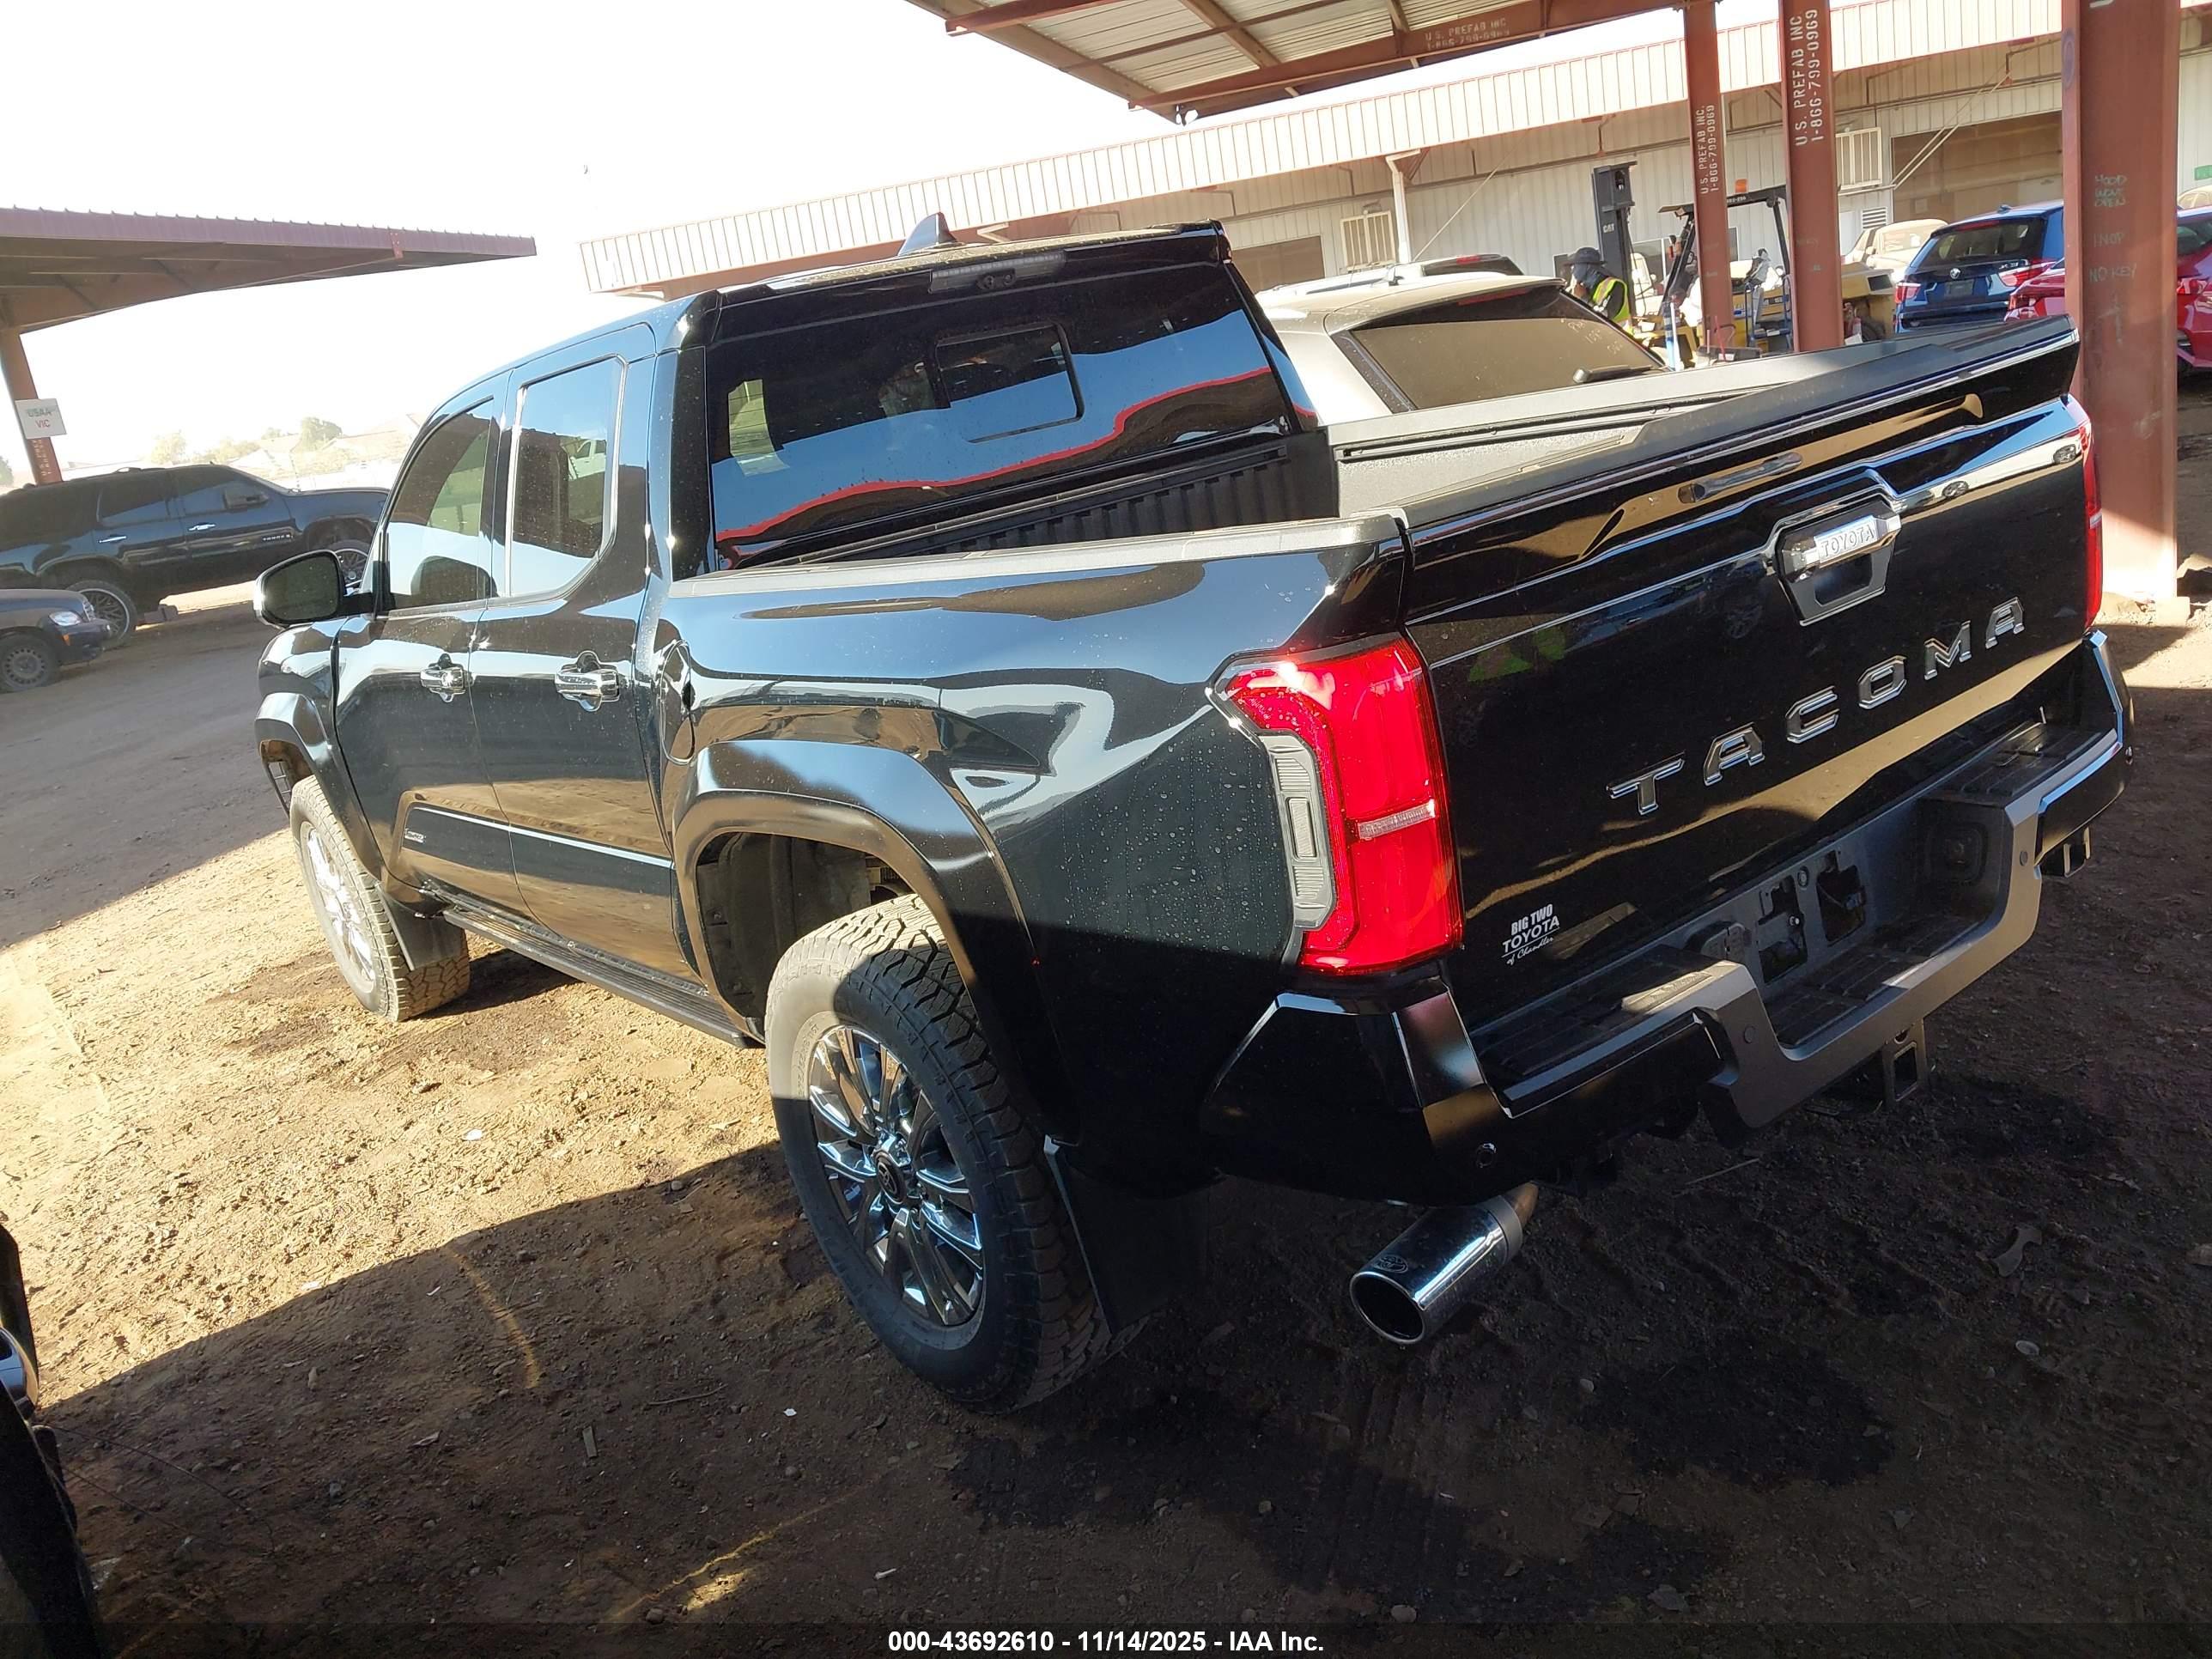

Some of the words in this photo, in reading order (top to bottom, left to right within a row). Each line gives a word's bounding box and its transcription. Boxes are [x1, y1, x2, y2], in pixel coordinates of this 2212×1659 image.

[1449, 21, 1486, 37] PREFAB
[1790, 15, 1804, 40] INC
[1791, 48, 1807, 108] PREFAB
[1805, 9, 1824, 141] 1-866-799-0969
[1706, 105, 1719, 191] 1-866-799-0969
[1795, 116, 1808, 146] U.S.
[1697, 130, 1707, 170] PREFAB
[1700, 174, 1709, 194] U.S.
[1602, 223, 1614, 233] CAT
[2089, 266, 2108, 283] NO
[2112, 263, 2137, 279] KEY
[1820, 523, 1875, 559] TOYOTA
[1605, 594, 2027, 817] TACOMA
[1502, 915, 1560, 953] TOYOTA
[1510, 915, 1529, 936] BIG
[1529, 903, 1553, 926] TWO
